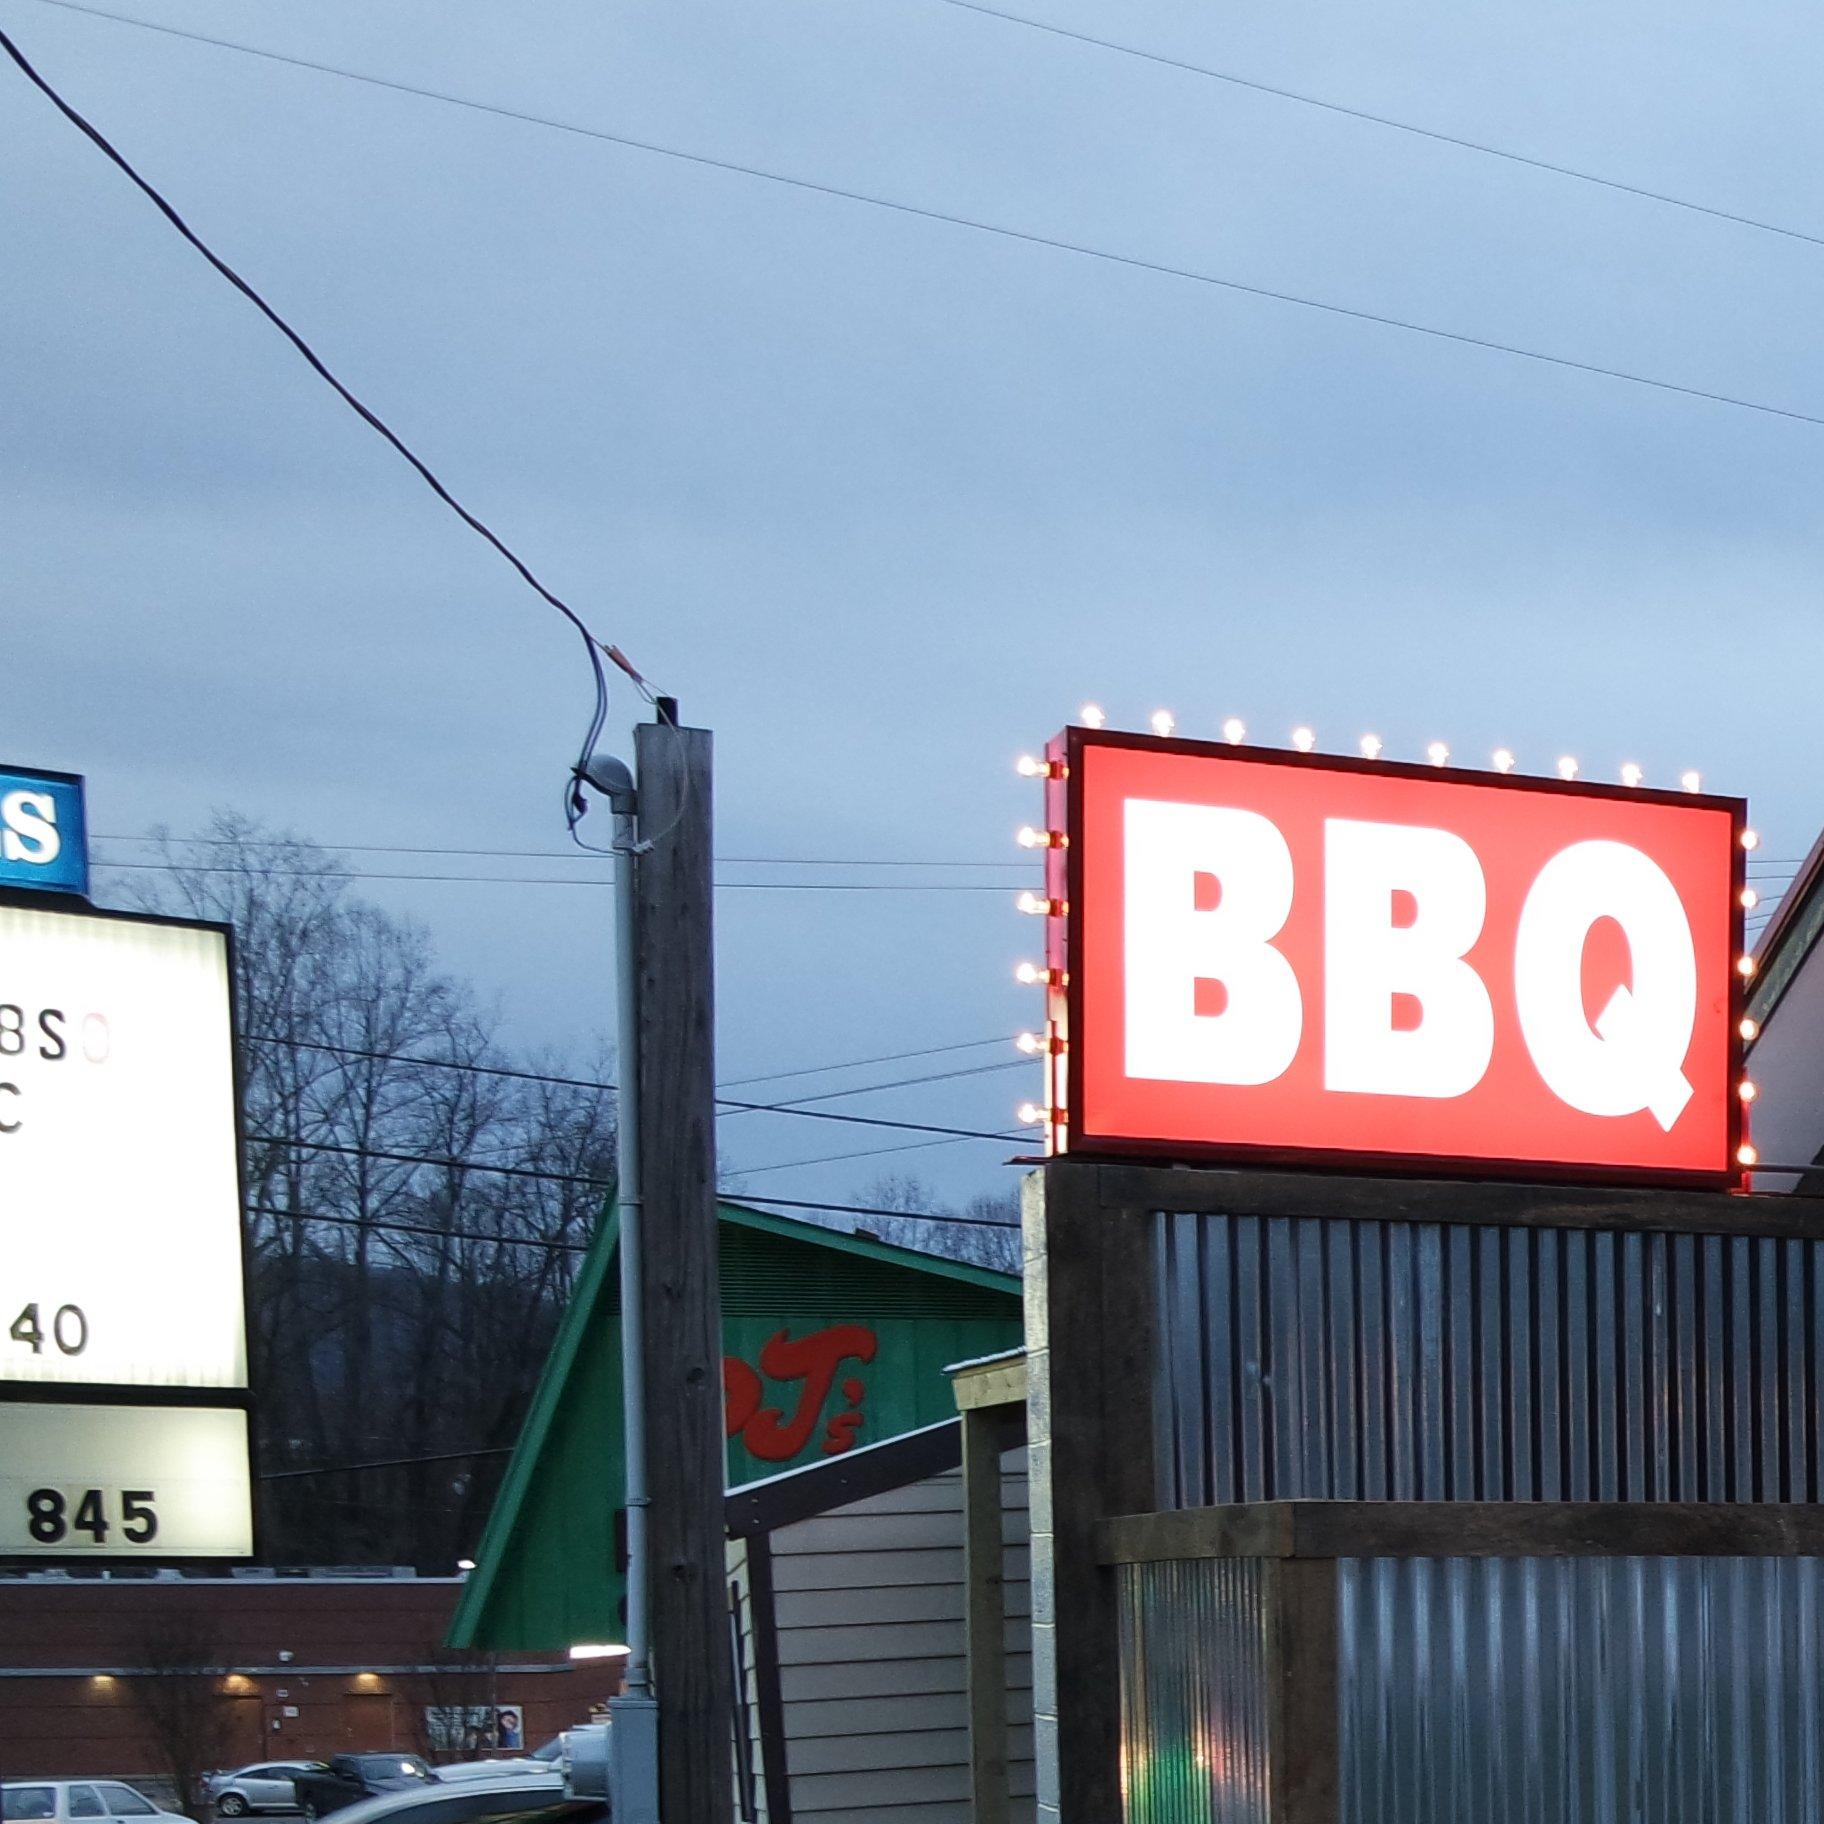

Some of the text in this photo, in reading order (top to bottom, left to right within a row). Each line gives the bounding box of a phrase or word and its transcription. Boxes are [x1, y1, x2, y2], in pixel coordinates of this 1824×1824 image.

[1124, 798, 1697, 1132] BBQ
[10, 1303, 89, 1356] 40
[27, 1488, 158, 1543] 845
